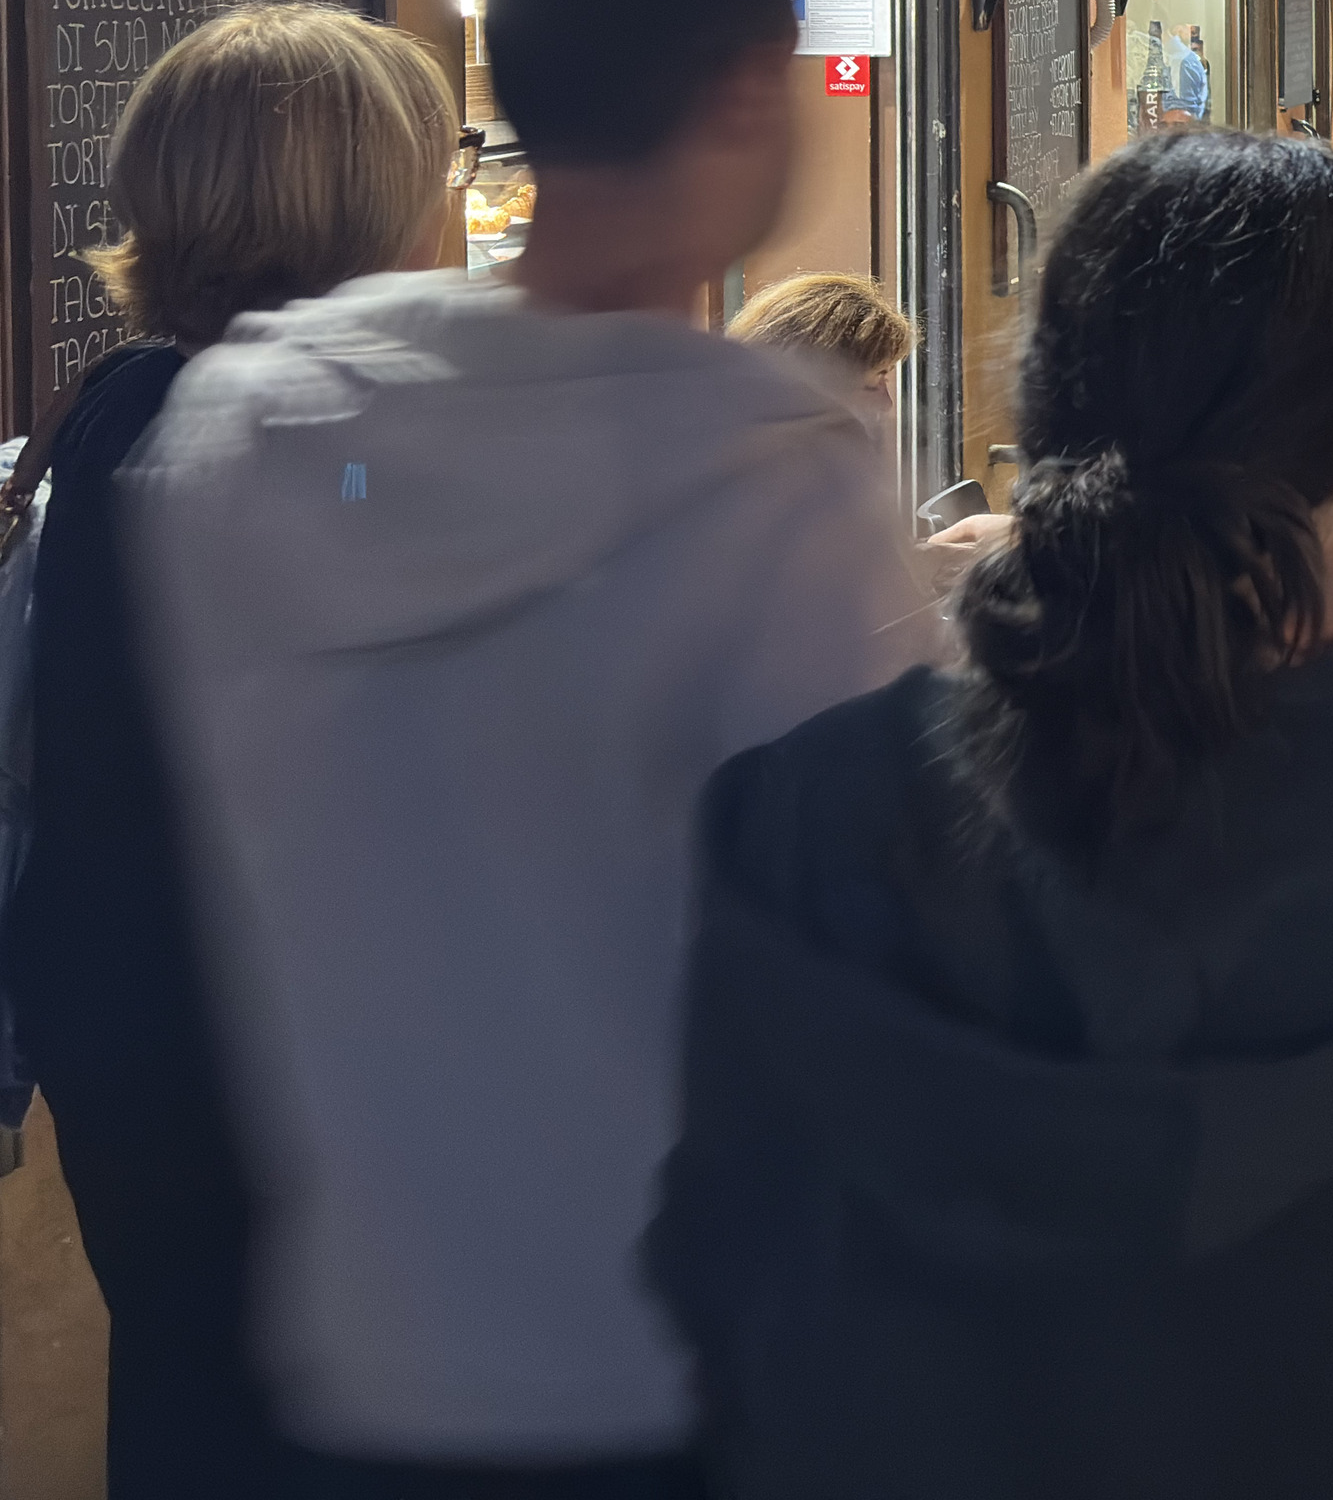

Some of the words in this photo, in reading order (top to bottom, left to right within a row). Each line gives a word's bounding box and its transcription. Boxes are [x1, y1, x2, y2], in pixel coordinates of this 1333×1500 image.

[57, 23, 85, 73] DI
[94, 17, 150, 74] SUA
[829, 82, 865, 92] satispay
[47, 134, 110, 188] TORT
